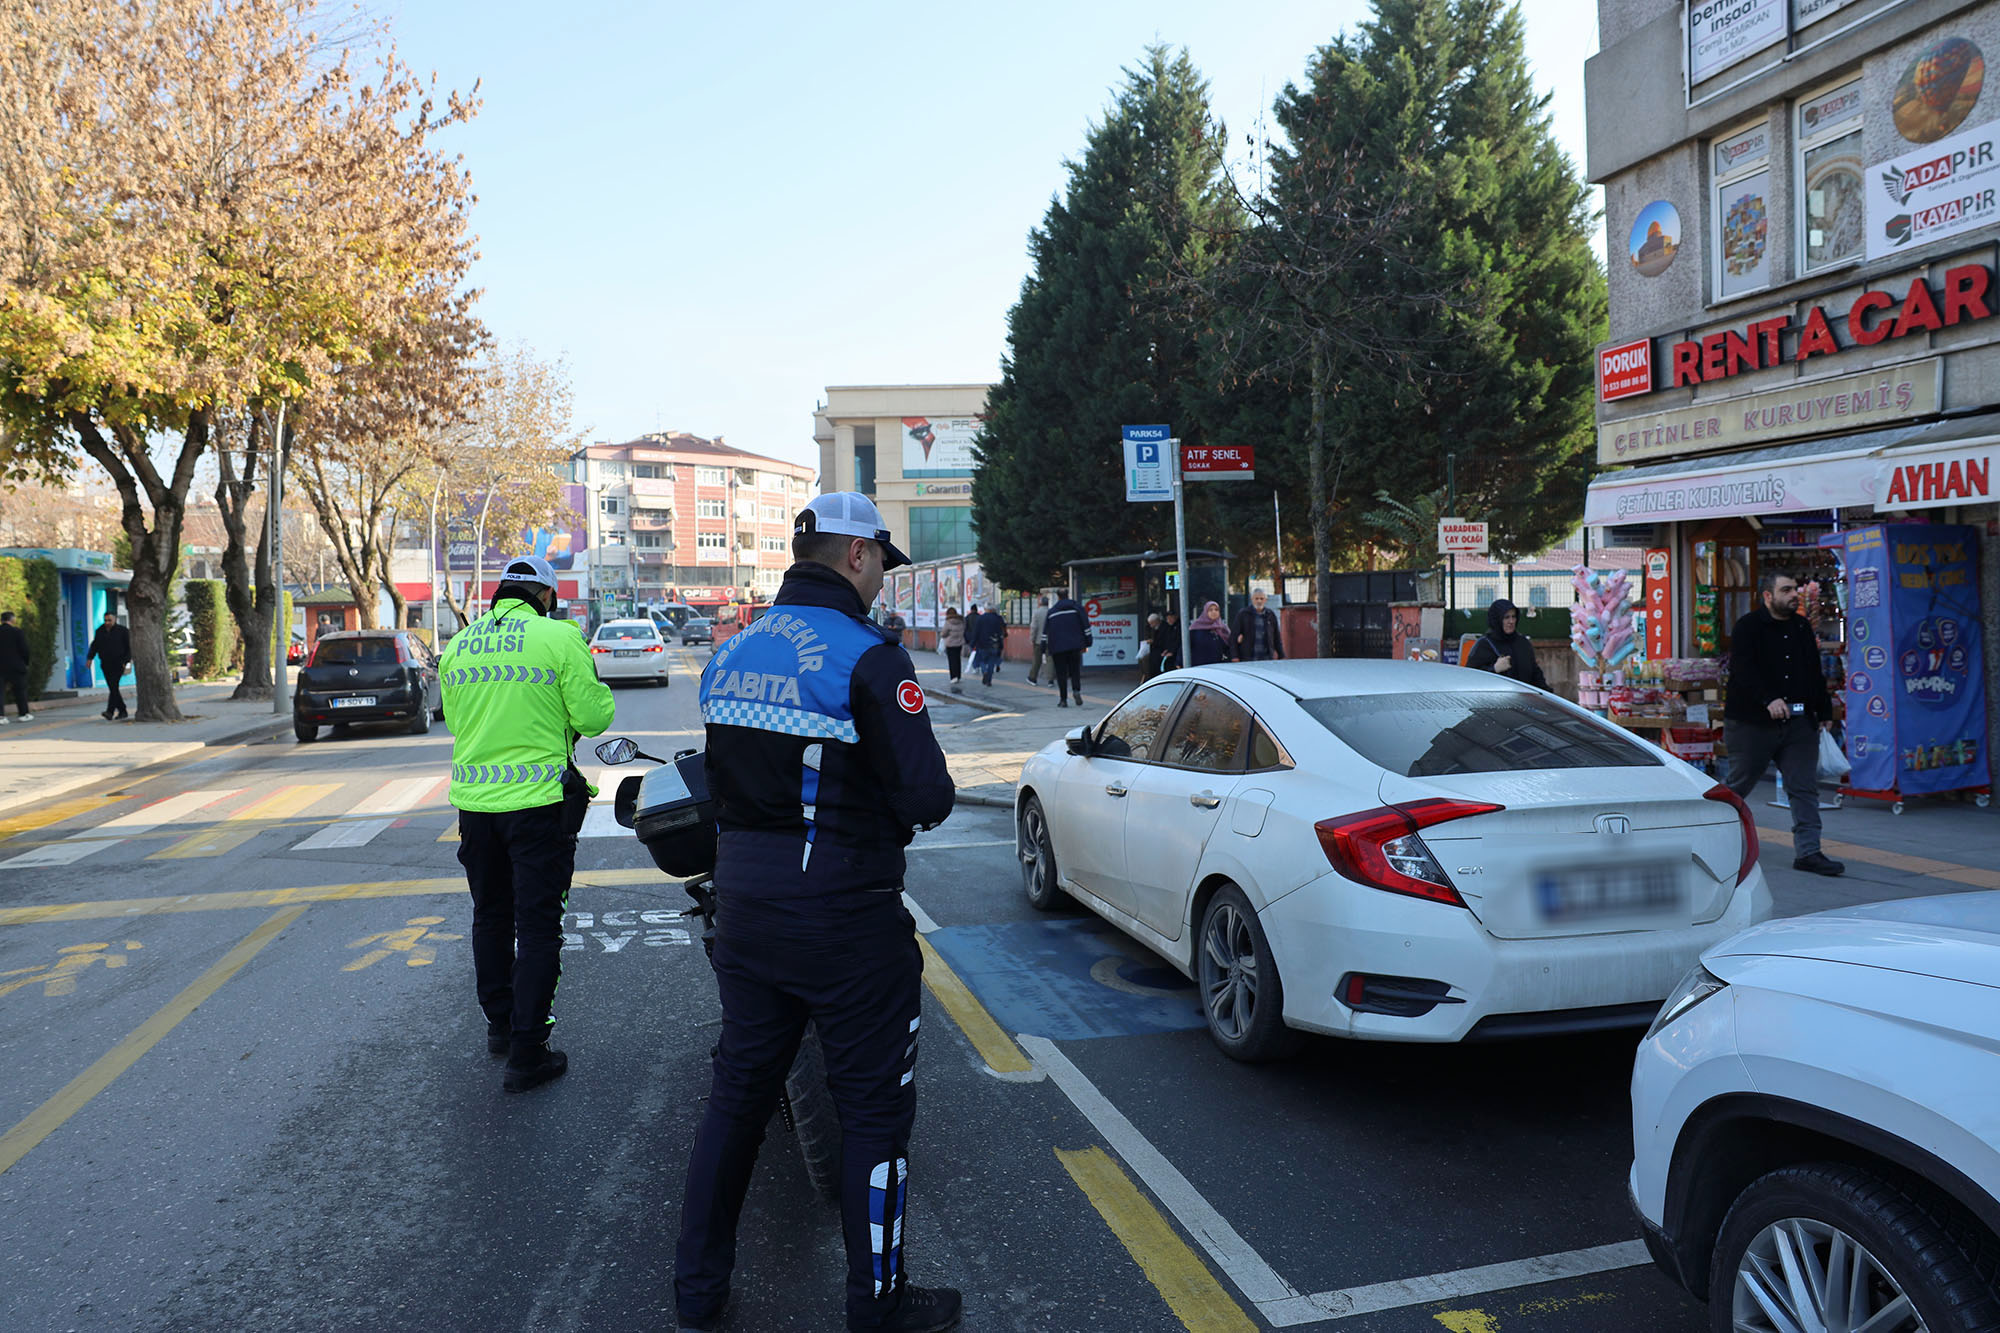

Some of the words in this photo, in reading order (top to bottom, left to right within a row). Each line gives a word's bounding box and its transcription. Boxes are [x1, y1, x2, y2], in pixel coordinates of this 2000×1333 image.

[1673, 315, 1788, 388] RENT
[1796, 306, 1839, 361] A
[1848, 264, 1990, 346] CAR
[1604, 347, 1647, 376] DORUK
[1615, 417, 1721, 456] ÇETİNLER
[1744, 381, 1914, 430] KURUYEMİŞ
[1129, 430, 1162, 438] PARK54
[1142, 446, 1153, 461] P
[1187, 449, 1208, 460] ATIF
[926, 484, 960, 494] Garanti
[1887, 457, 1989, 504] AYHAN
[1616, 487, 1687, 519] ÇETİNLER
[1688, 473, 1785, 509] KURUYEMİŞ
[1443, 524, 1484, 533] KARADENİZ
[1445, 535, 1458, 545] ÇAY
[1461, 534, 1483, 543] OCAĞI
[1088, 603, 1098, 616] 2
[464, 617, 529, 637] TRAFİK
[1089, 619, 1131, 627] METROBÜS
[456, 635, 525, 656] POLİSİ
[709, 669, 801, 707] ZABITA
[560, 909, 685, 928] nce
